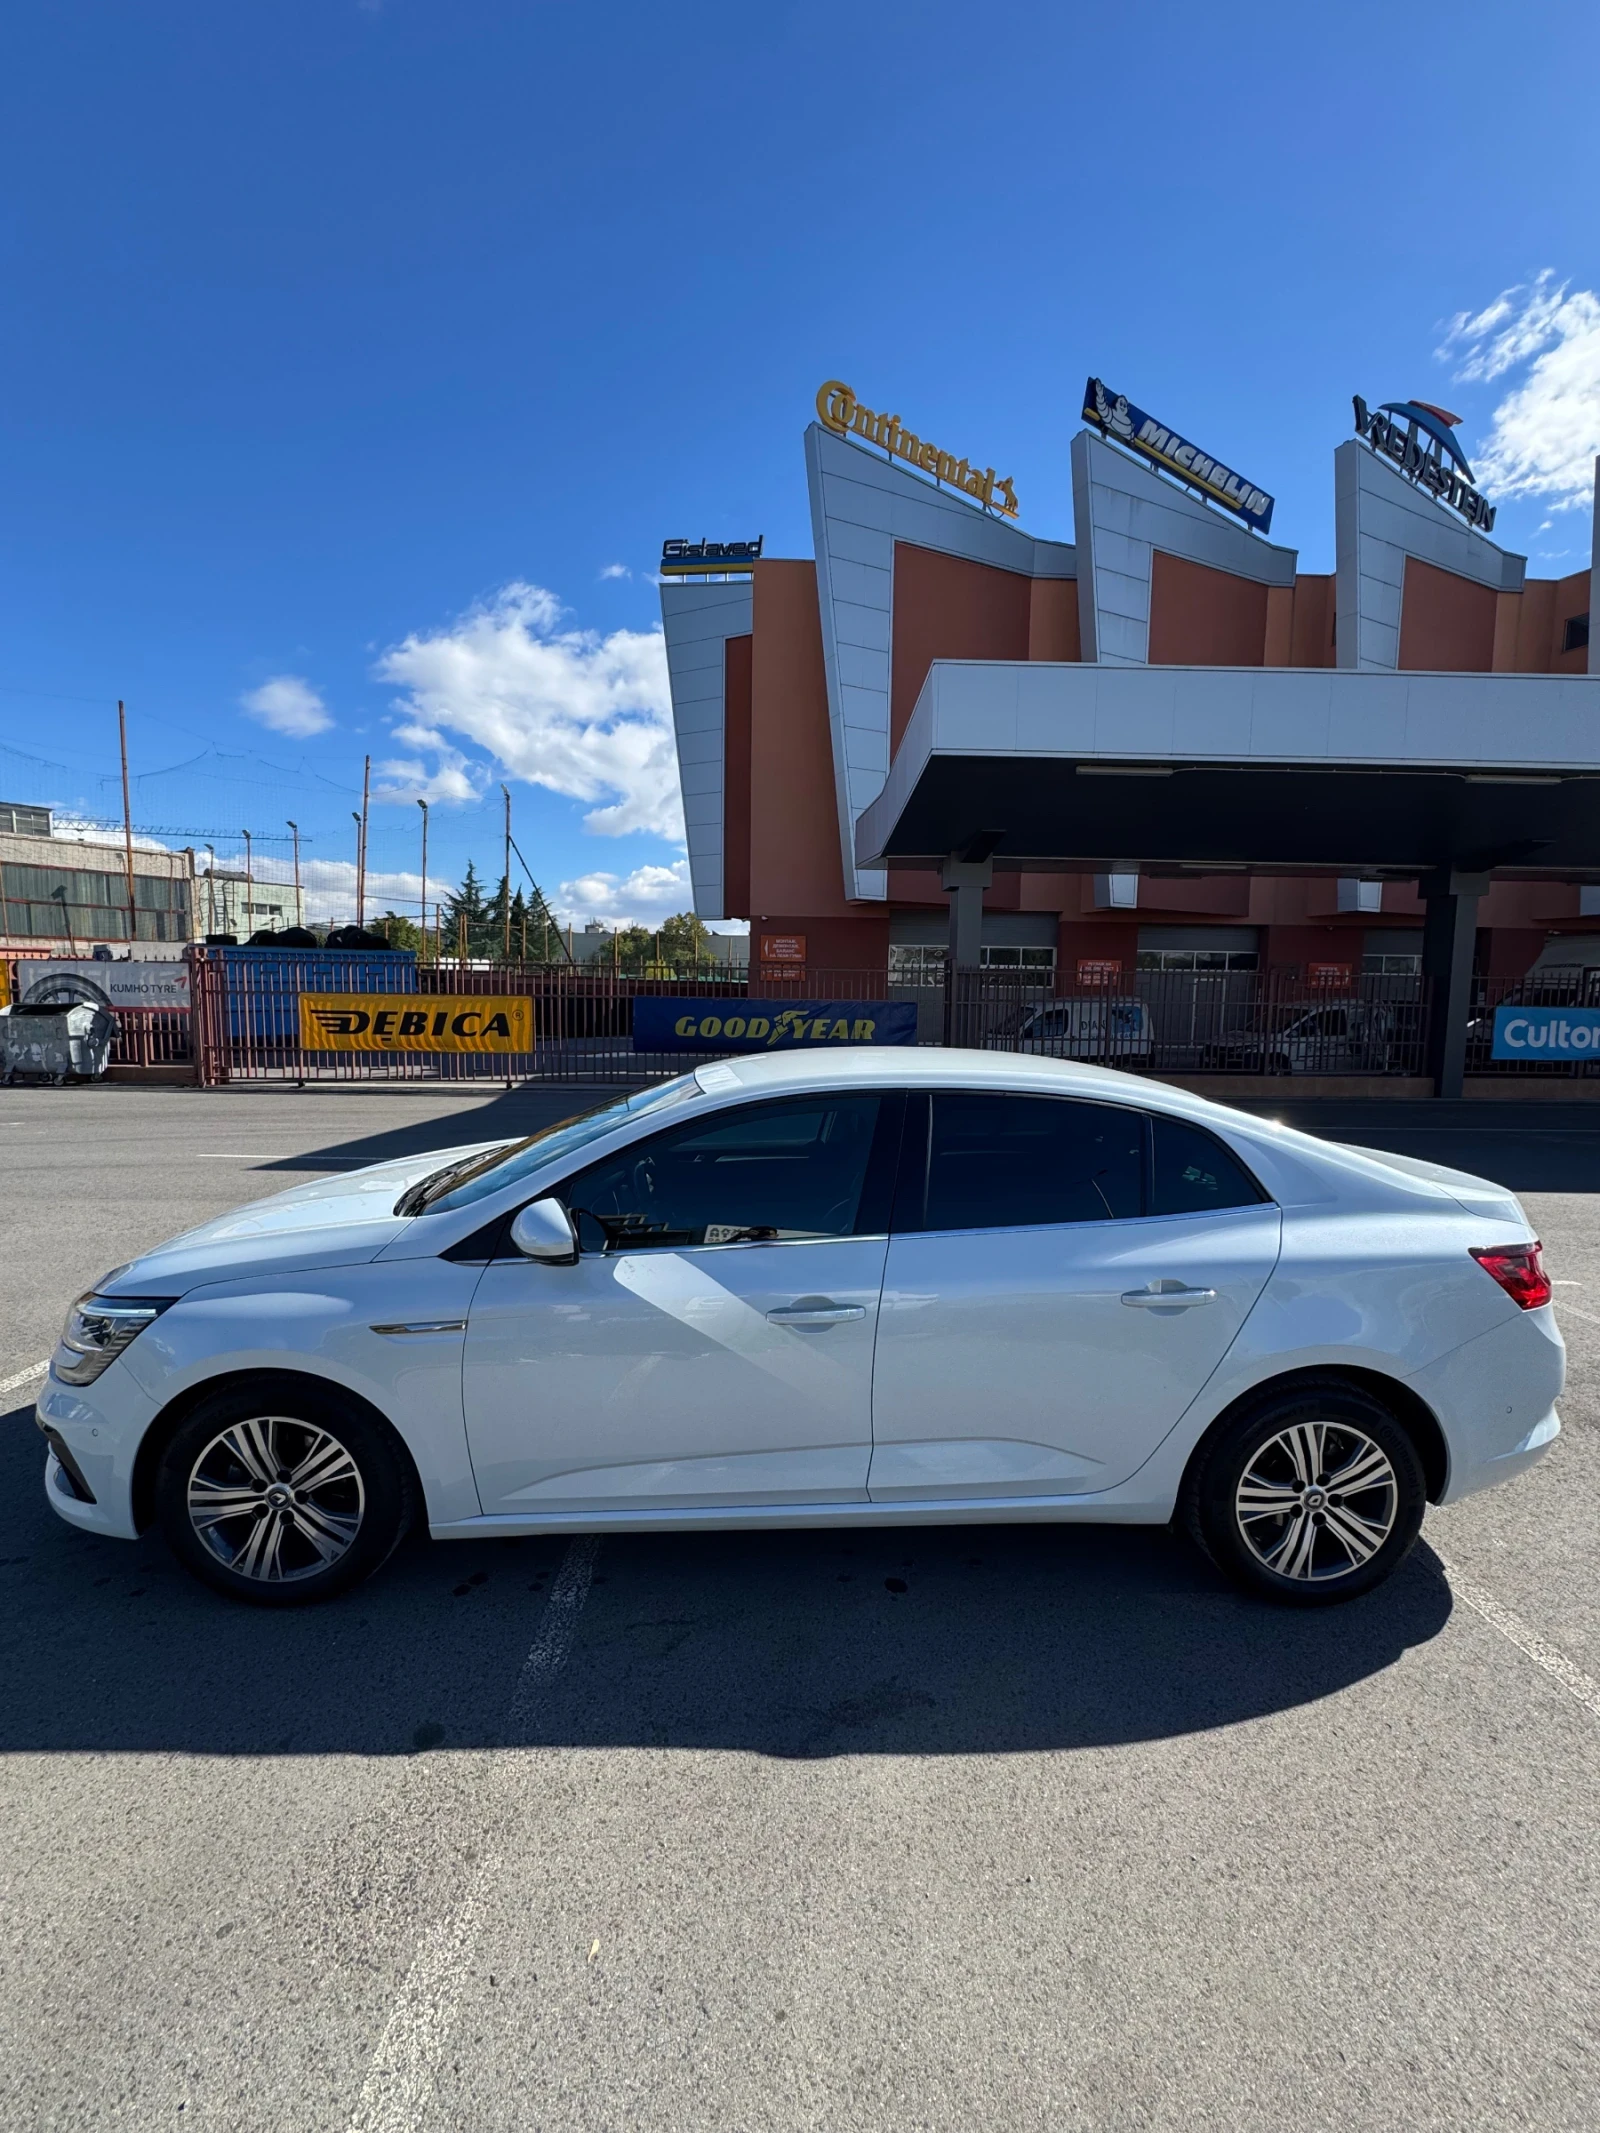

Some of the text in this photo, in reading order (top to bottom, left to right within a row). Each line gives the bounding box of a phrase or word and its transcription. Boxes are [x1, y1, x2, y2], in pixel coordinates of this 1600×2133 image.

[816, 380, 996, 505] Continental
[1136, 419, 1270, 516] MICHELIN
[1352, 394, 1497, 533] VREDESTEIN
[663, 535, 763, 558] Gislaved
[110, 983, 177, 993] KUMHO TYRE
